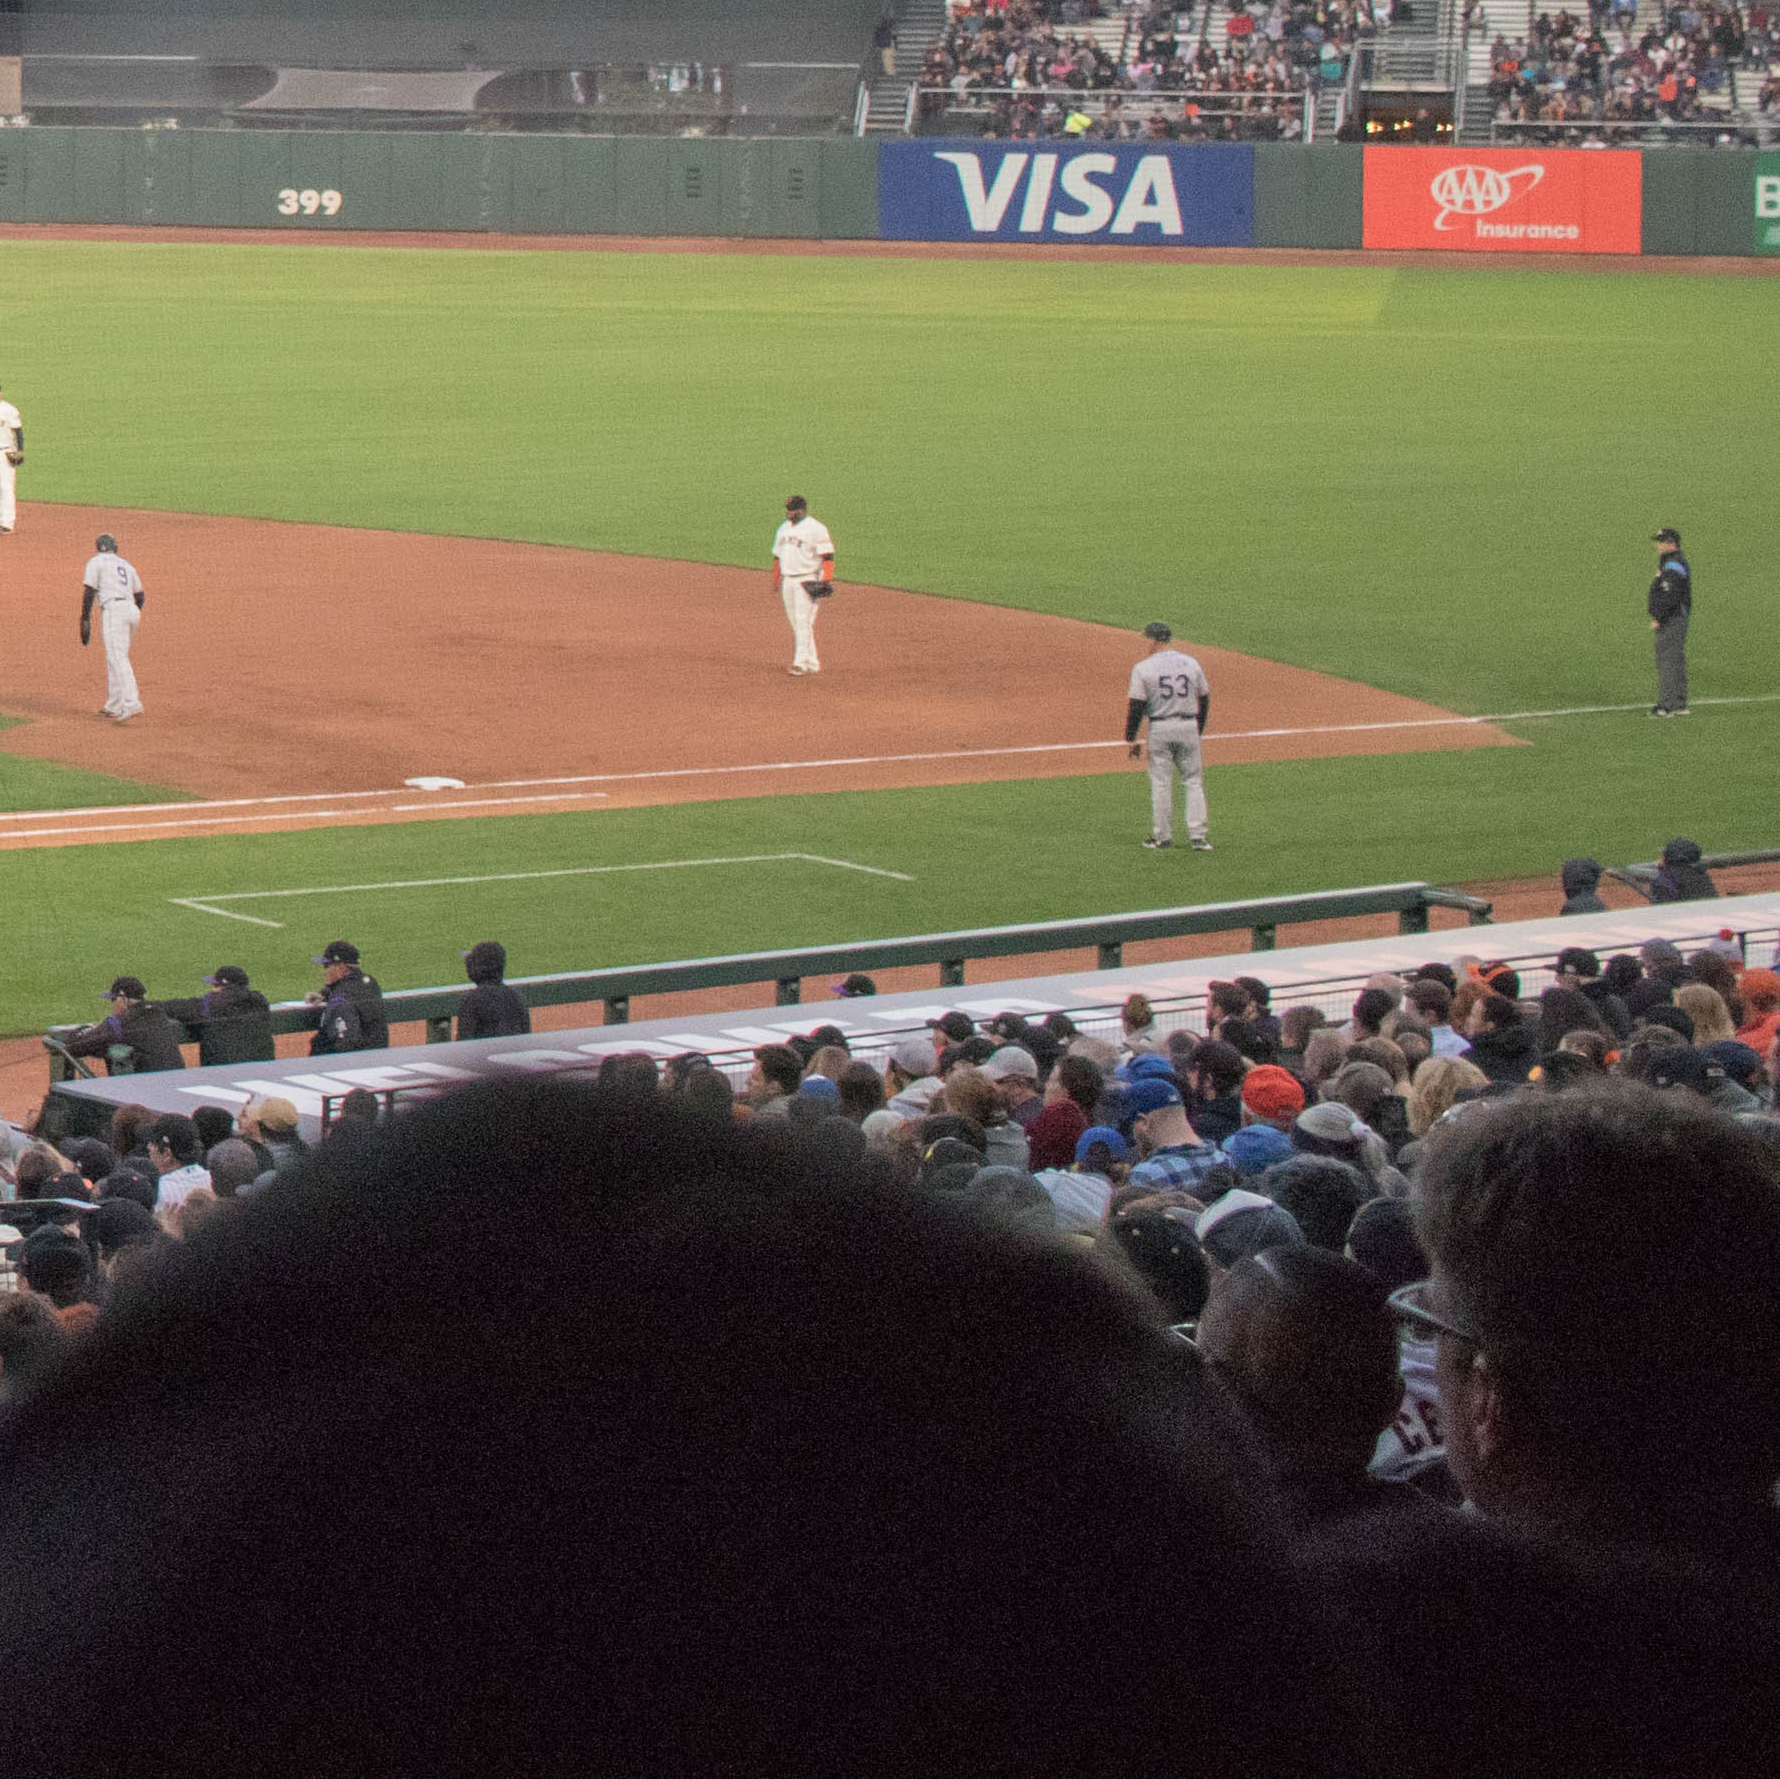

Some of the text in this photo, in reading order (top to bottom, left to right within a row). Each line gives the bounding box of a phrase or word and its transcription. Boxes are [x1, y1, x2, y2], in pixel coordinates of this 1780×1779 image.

[278, 188, 343, 216] 399
[932, 151, 1184, 236] VISA
[1440, 167, 1505, 212] AAA
[1475, 219, 1580, 240] Insurance
[116, 565, 130, 586] 9
[1157, 674, 1190, 700] 53
